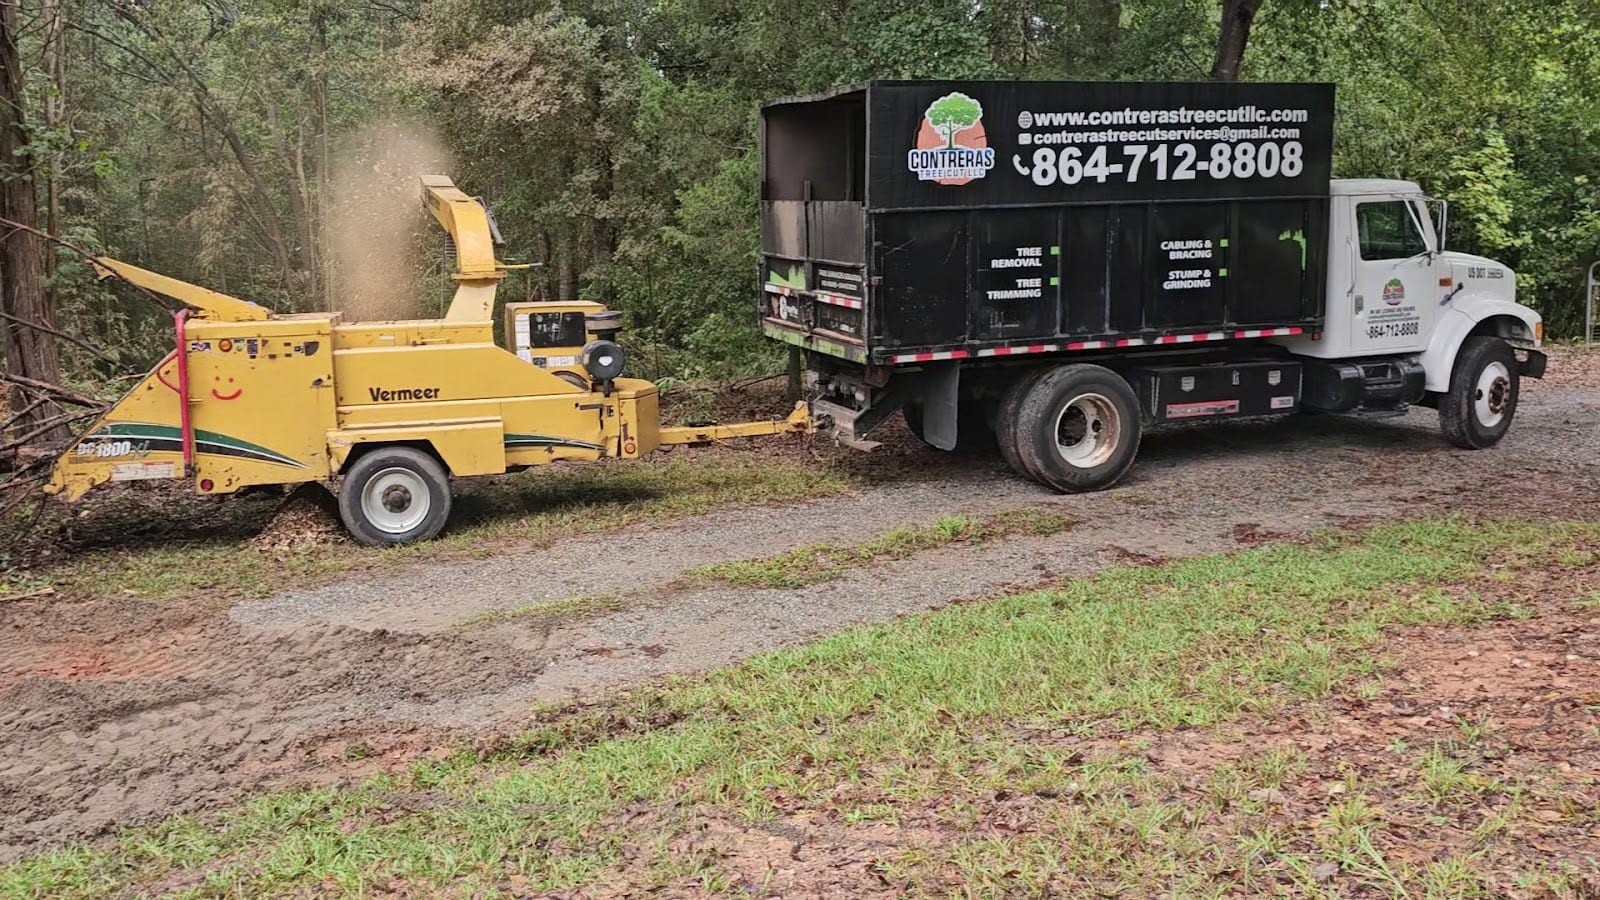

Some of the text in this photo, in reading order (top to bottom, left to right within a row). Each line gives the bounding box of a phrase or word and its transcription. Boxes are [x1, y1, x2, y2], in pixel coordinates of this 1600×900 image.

[1034, 106, 1308, 126] www.contrerastreecutllc.com
[1034, 126, 1300, 144] contrerastreecutservices@gmail.com
[911, 150, 992, 168] CONTRERAS
[1032, 142, 1303, 185] 864-712-8808
[1160, 240, 1212, 250] CABLING &
[1016, 247, 1042, 257] TREE
[1169, 250, 1212, 260] BRACING
[991, 258, 1042, 269] REMOVAL
[1168, 269, 1211, 280] STUMP &
[1016, 278, 1042, 288] TREE
[1163, 279, 1211, 289] GRINDING
[986, 288, 1041, 300] TRIMMING
[368, 387, 440, 402] Vermeer
[96, 441, 131, 457] 1800
